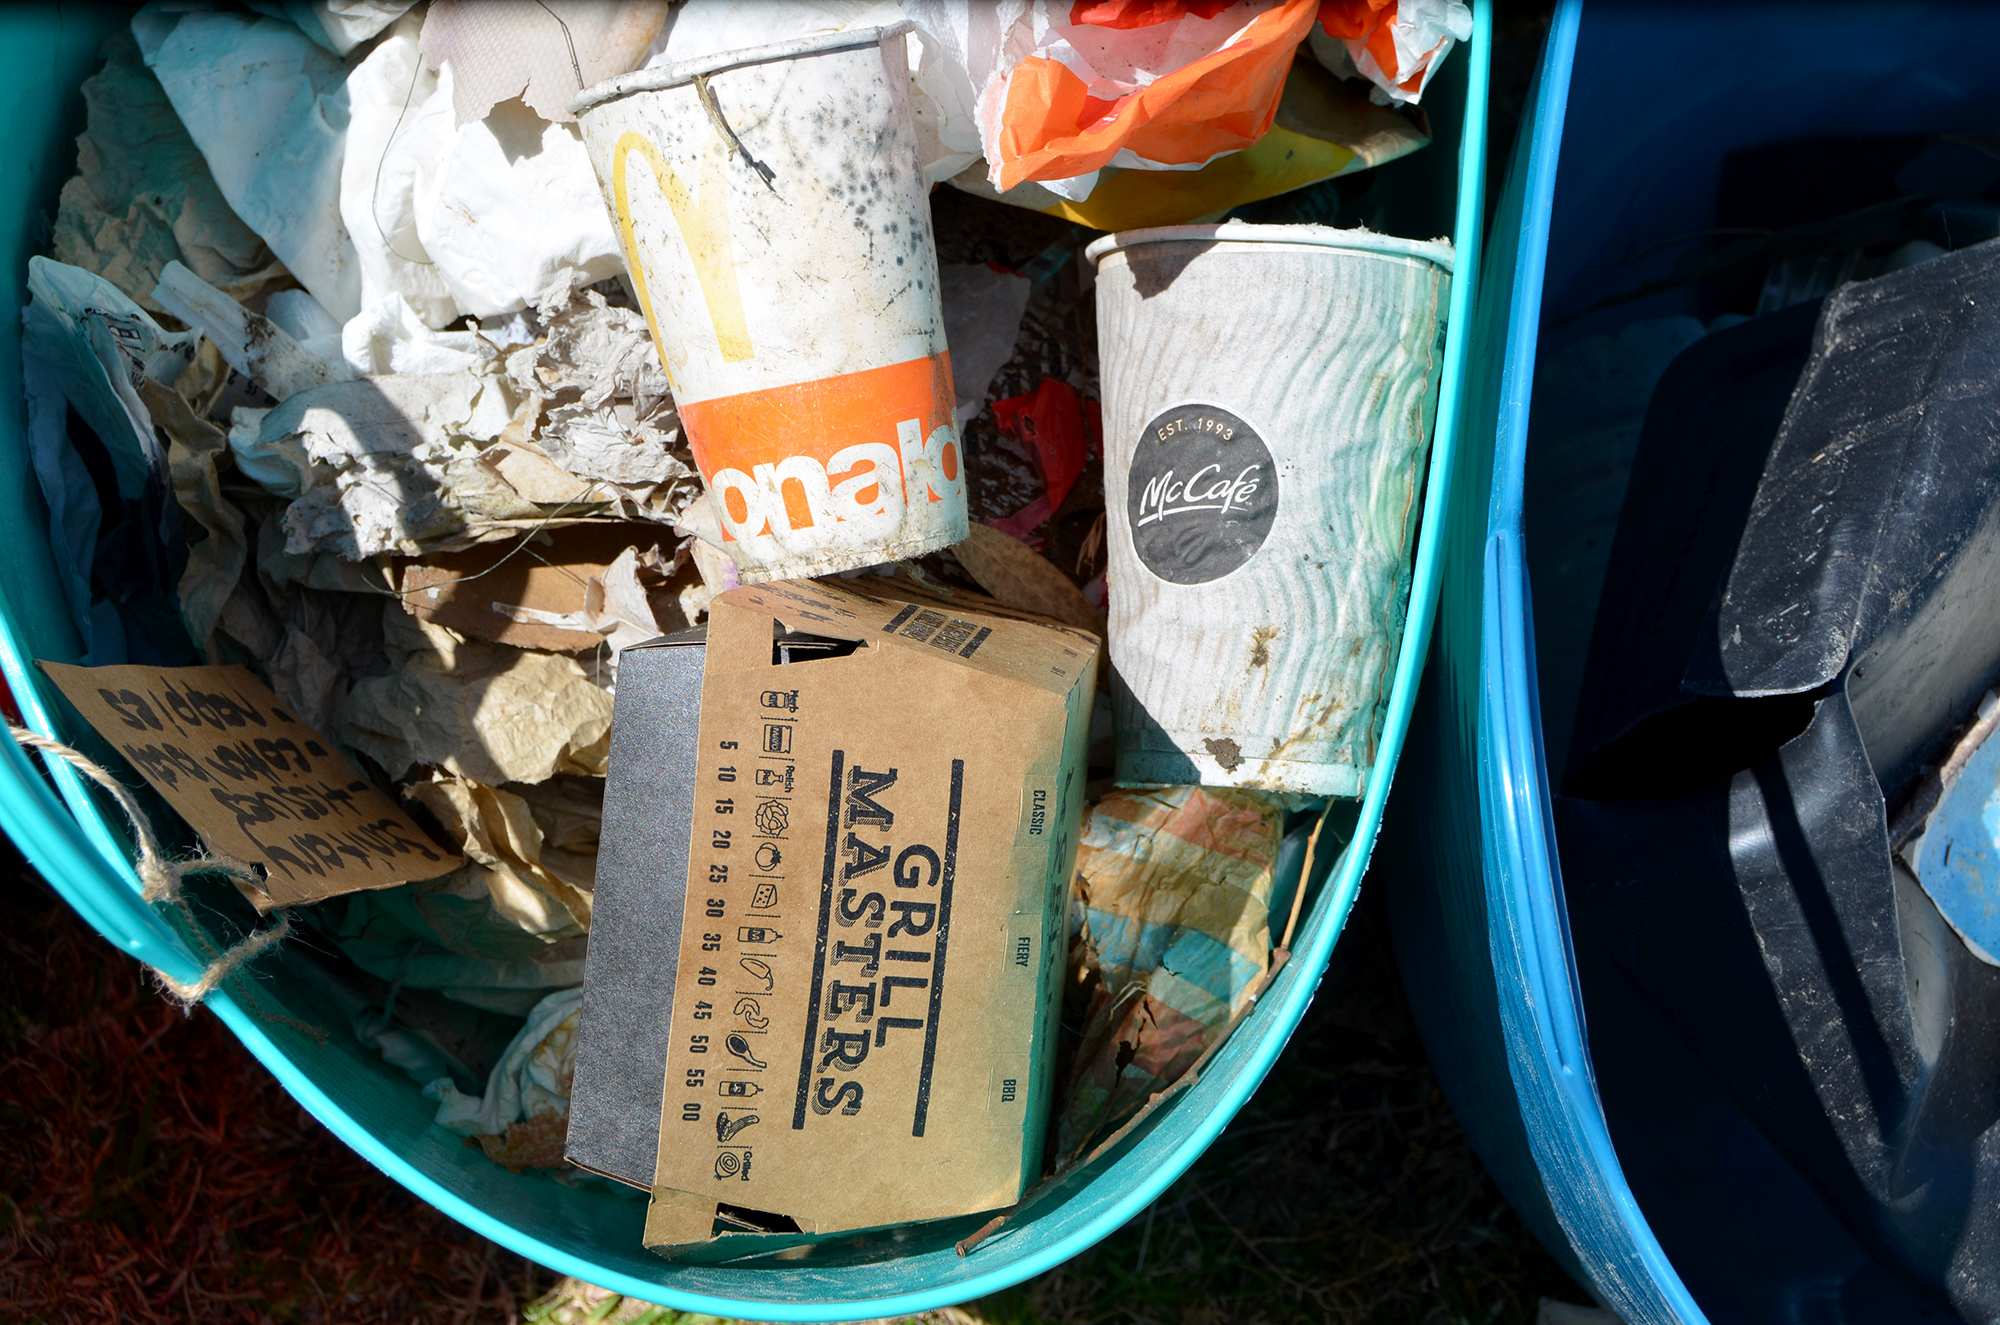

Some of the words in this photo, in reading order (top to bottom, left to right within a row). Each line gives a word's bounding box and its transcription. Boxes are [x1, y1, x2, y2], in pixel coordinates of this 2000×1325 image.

[1157, 419, 1188, 441] EST.
[1198, 418, 1234, 441] 1993
[1138, 464, 1260, 527] McCafé
[720, 740, 738, 750] 5
[718, 766, 737, 782] 10
[784, 765, 795, 793] Relish
[715, 798, 734, 815] 15
[1029, 789, 1046, 836] CLASSIC
[712, 830, 731, 849] 20
[709, 864, 728, 883] 25
[705, 898, 725, 918] 30
[701, 933, 721, 951] 35
[811, 765, 898, 1116] MASTERS
[875, 843, 941, 1048] GRILL
[1015, 935, 1031, 967] FIERY
[698, 966, 717, 986] 40
[693, 1001, 713, 1020] 45
[689, 1035, 709, 1054] 50
[685, 1069, 705, 1088] 55
[1001, 1078, 1016, 1102] BBQ
[682, 1103, 701, 1121] 00
[741, 1151, 752, 1182] Grilled
